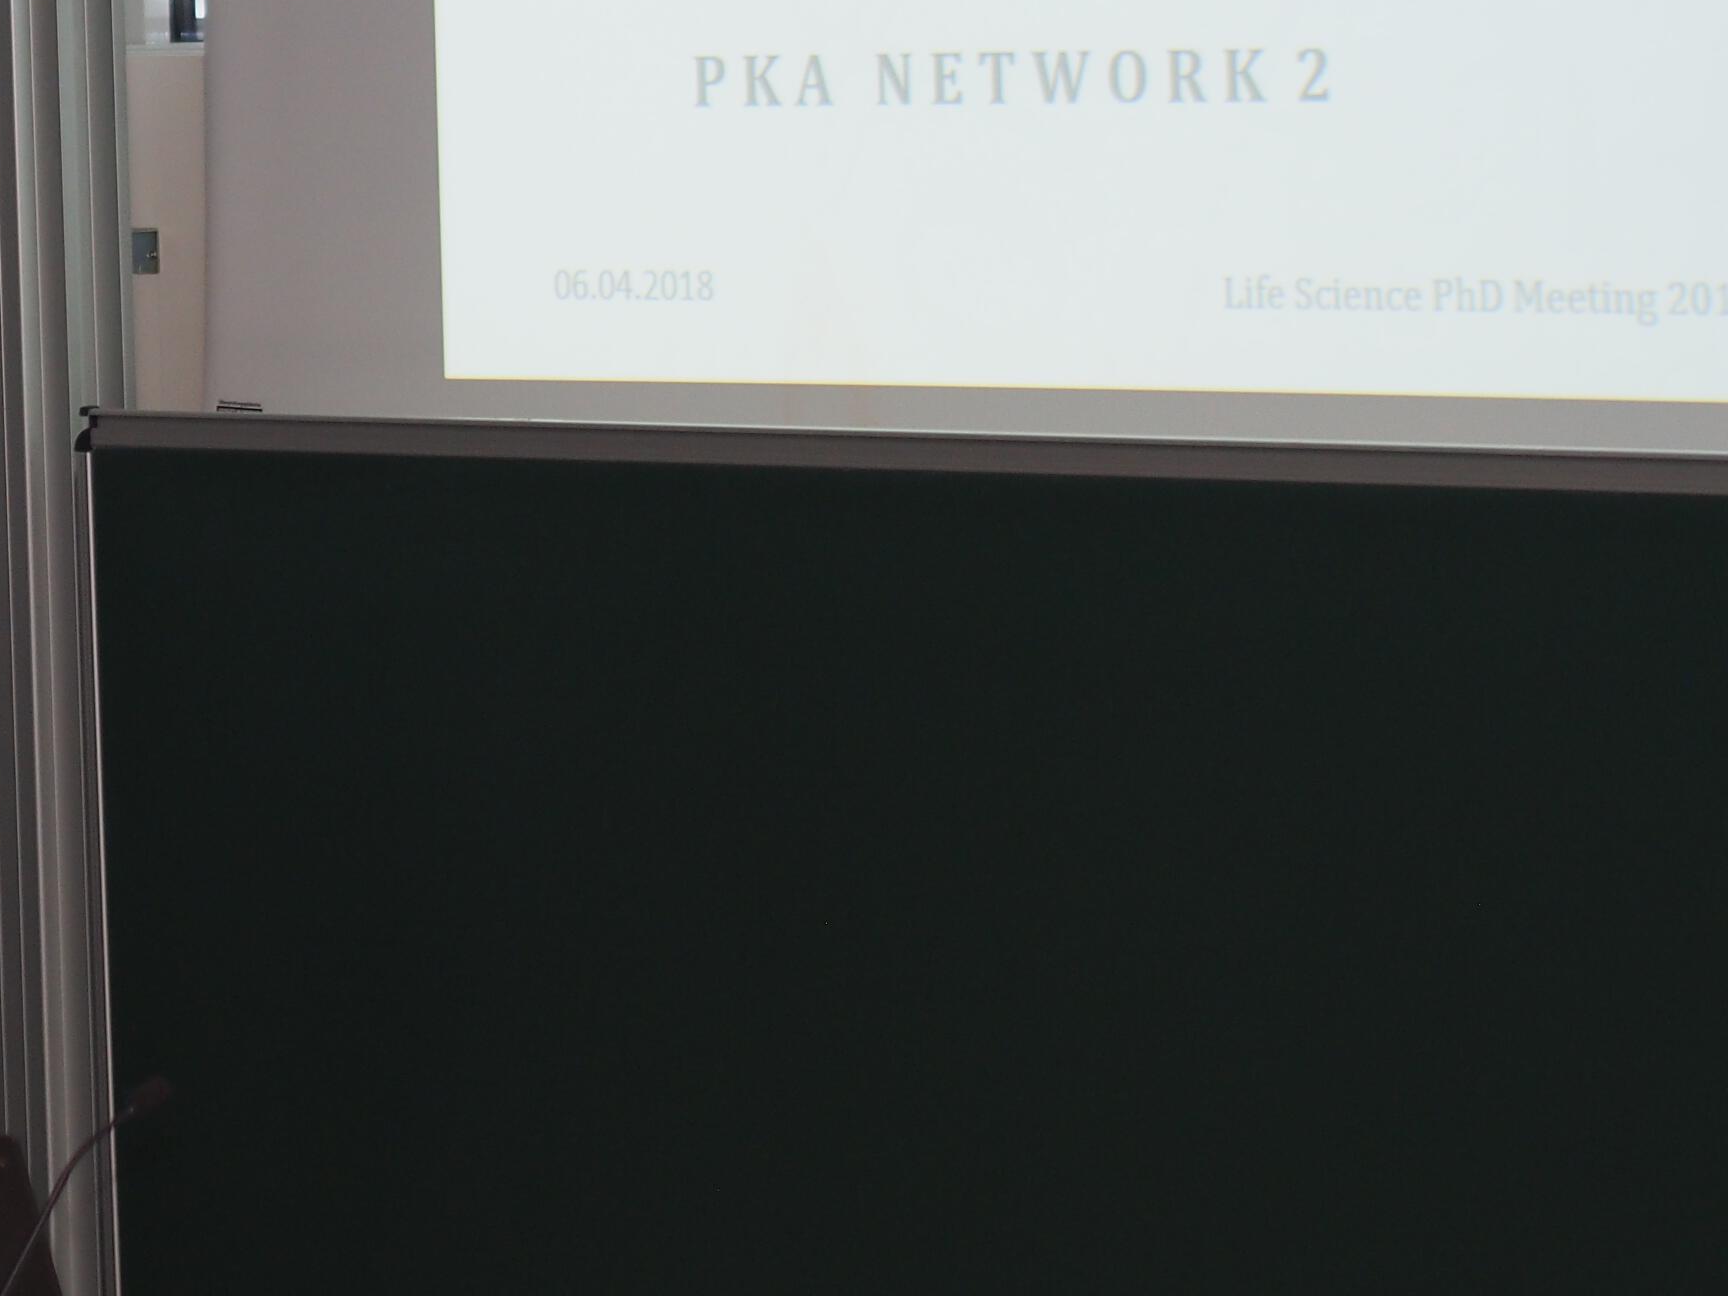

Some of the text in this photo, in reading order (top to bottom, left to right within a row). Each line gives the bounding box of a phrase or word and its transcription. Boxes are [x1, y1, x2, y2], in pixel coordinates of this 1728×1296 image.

[692, 46, 1330, 108] PKA NETWORK 2
[553, 268, 715, 302] 06.04.2018
[1223, 274, 1285, 311] Life
[1294, 276, 1423, 312] Science
[1432, 277, 1504, 313] PhD
[1513, 278, 1659, 326] Meeting
